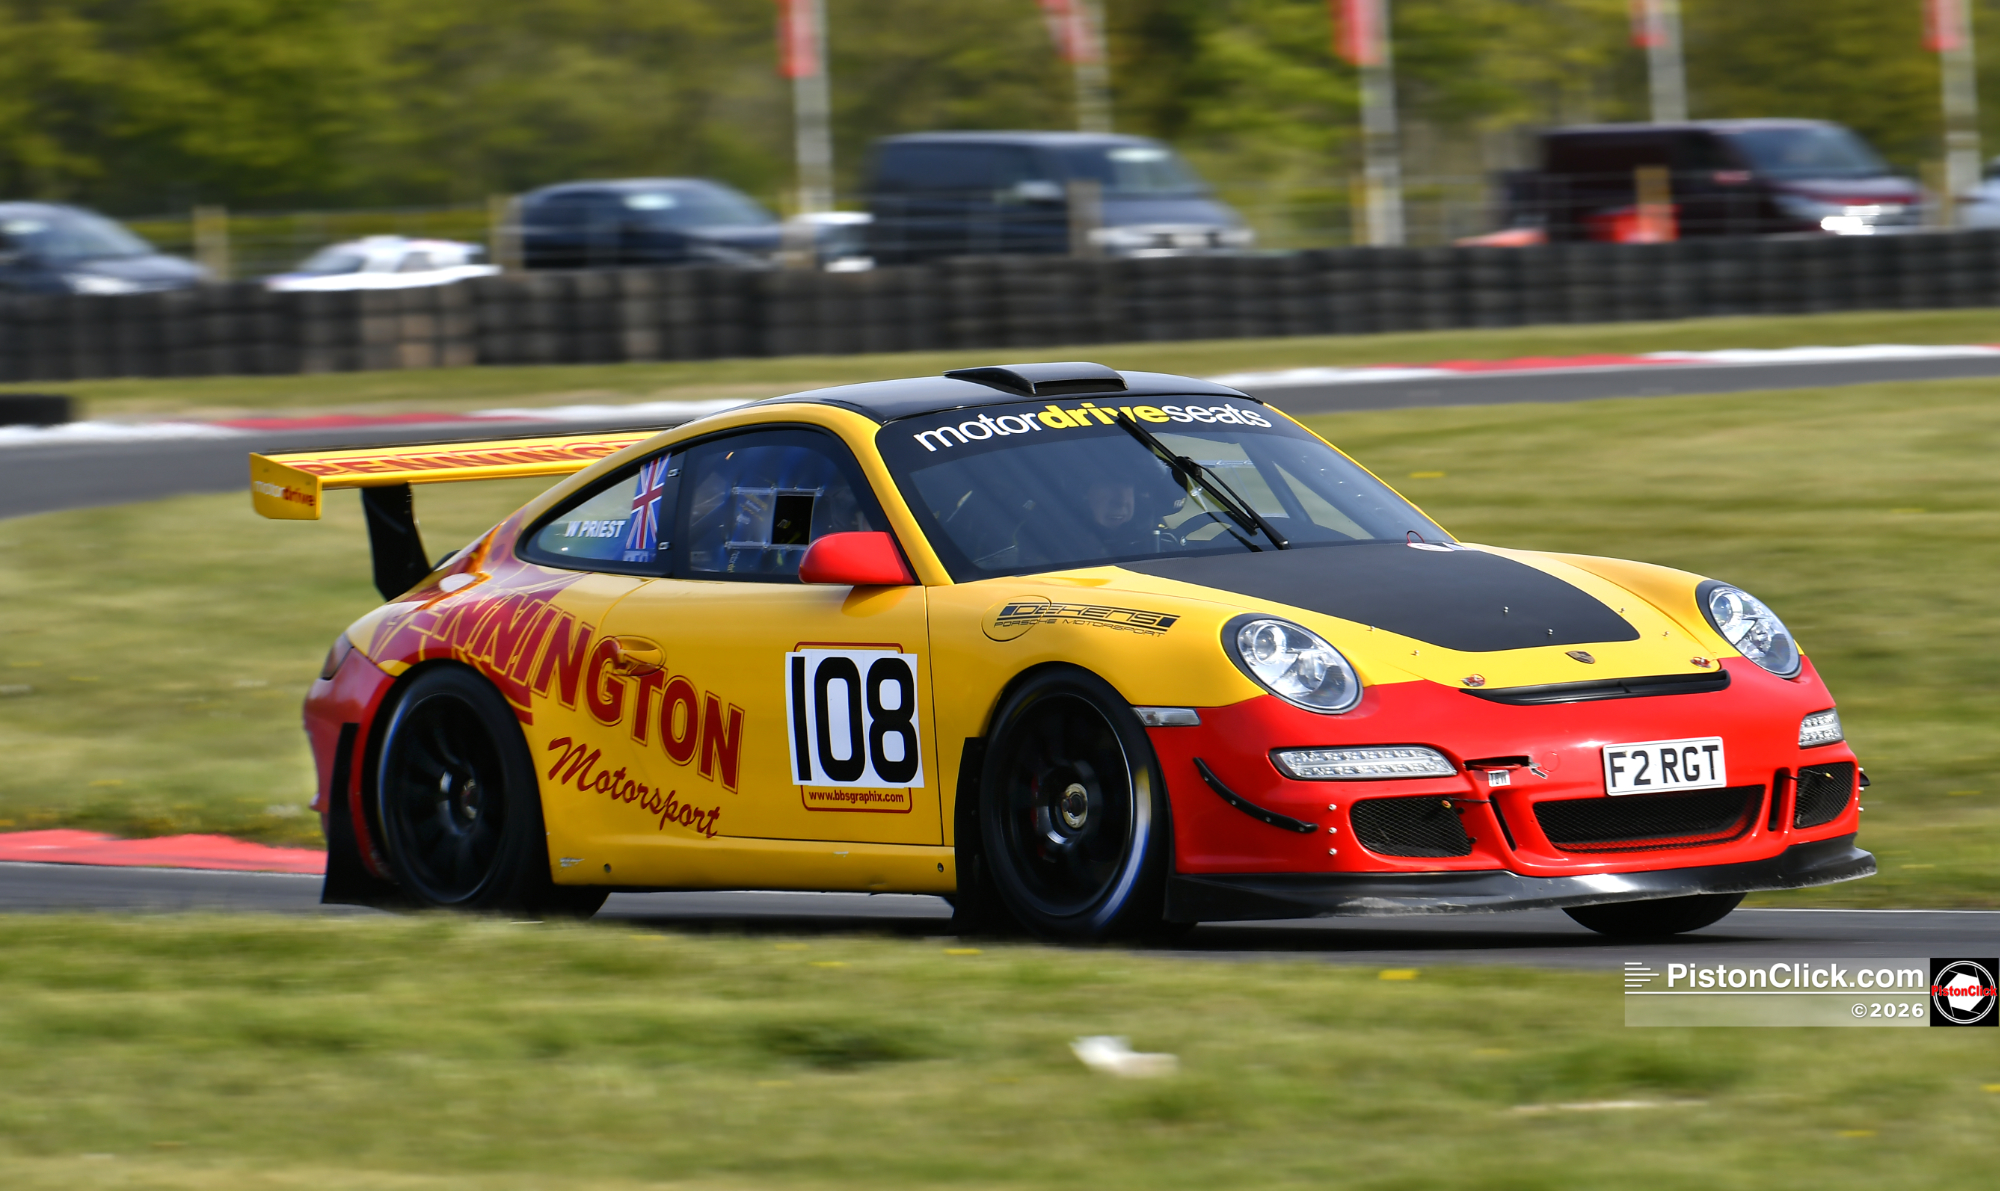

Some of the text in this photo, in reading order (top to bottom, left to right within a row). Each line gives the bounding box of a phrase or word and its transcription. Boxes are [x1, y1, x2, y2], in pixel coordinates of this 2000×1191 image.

[564, 520, 627, 538] W PRIEST
[993, 618, 1165, 638] PORSCHE MOTORSPORT
[406, 586, 746, 795] ENNINGTON
[791, 656, 919, 784] 108
[547, 736, 721, 839] Motorsport
[1608, 745, 1720, 788] F2 RGT
[808, 790, 905, 805] www.bbsgraphix.com
